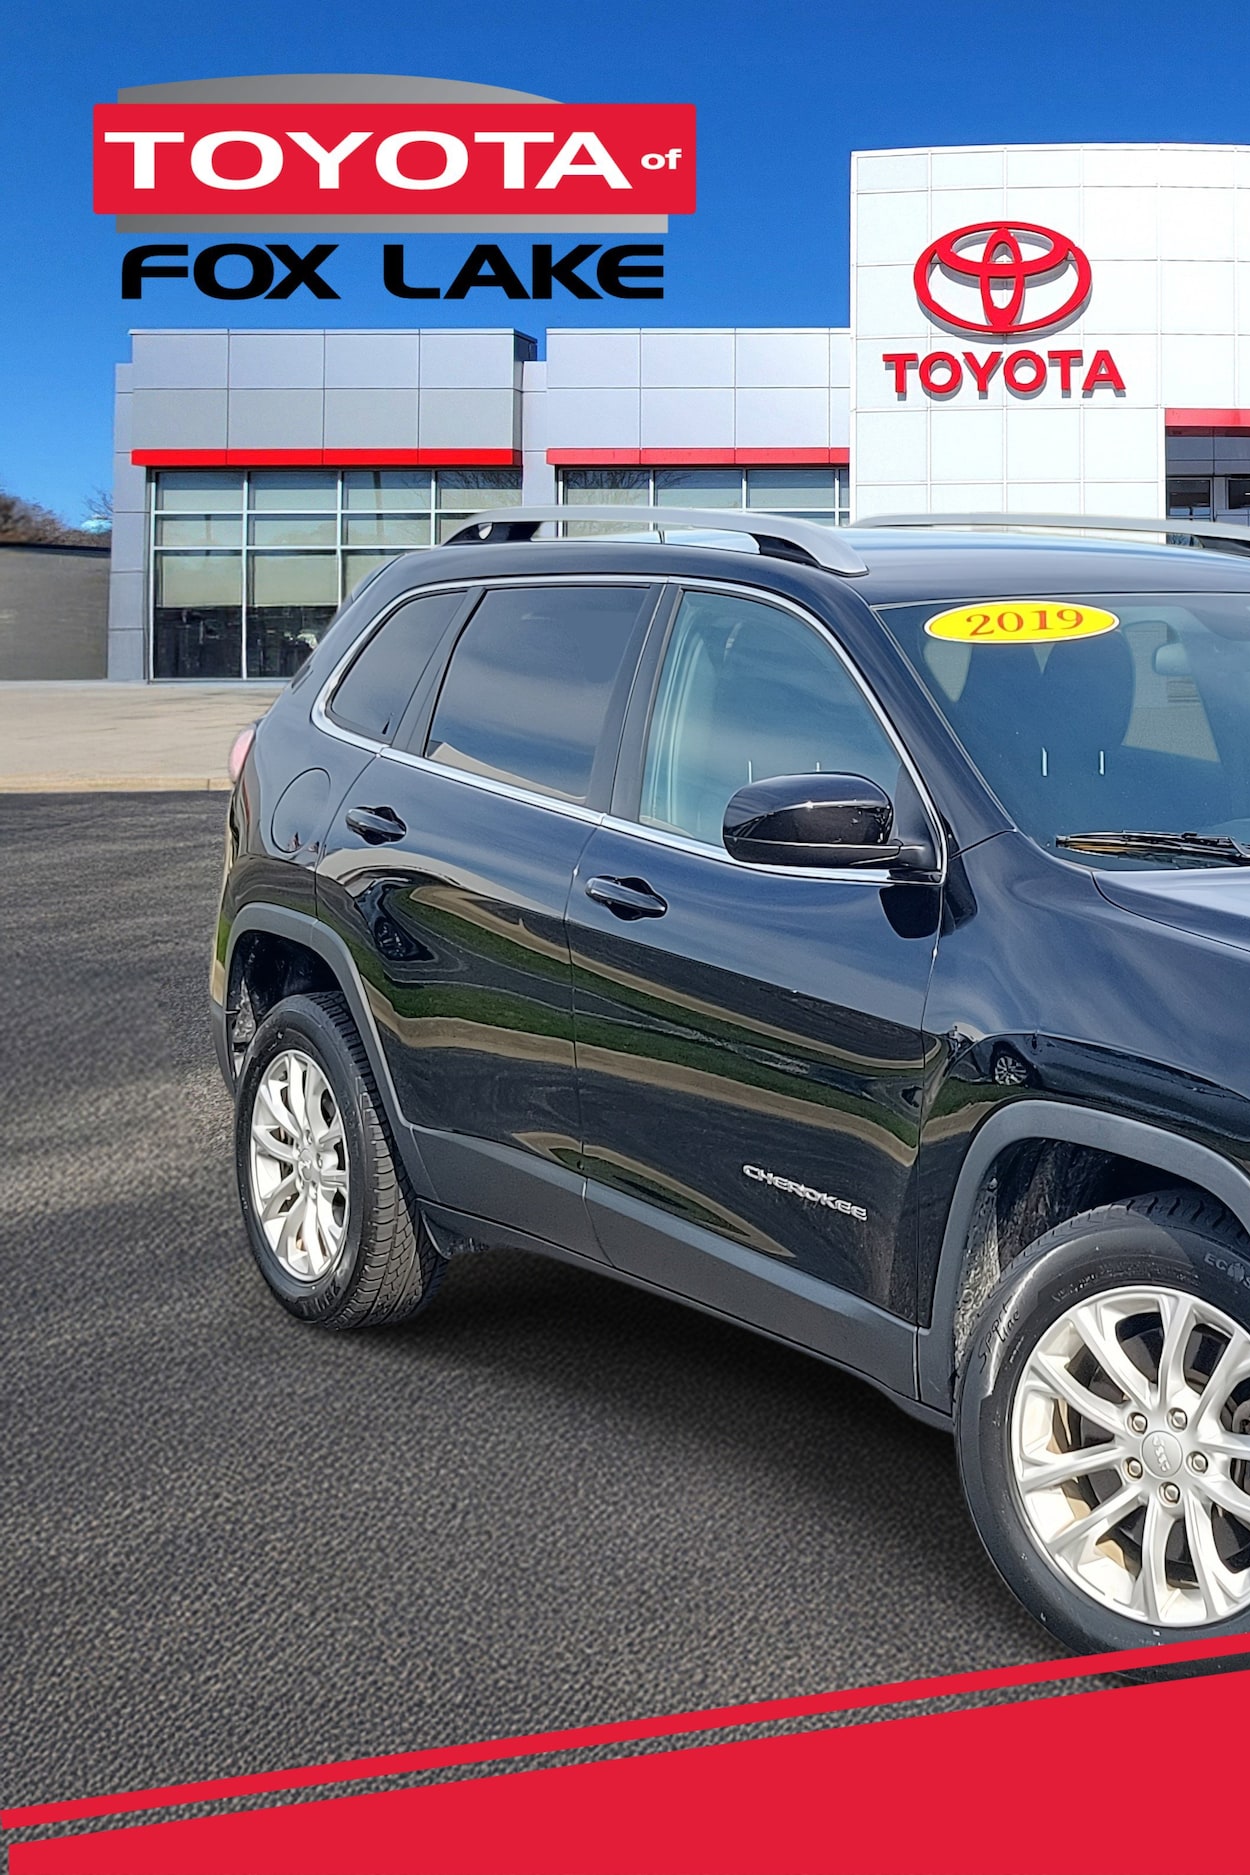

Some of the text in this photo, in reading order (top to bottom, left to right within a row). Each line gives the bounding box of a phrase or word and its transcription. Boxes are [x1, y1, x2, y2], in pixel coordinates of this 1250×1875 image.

[882, 350, 1127, 399] TOYOTA
[966, 608, 1083, 637] 2019
[742, 1164, 868, 1221] CHEROKEE
